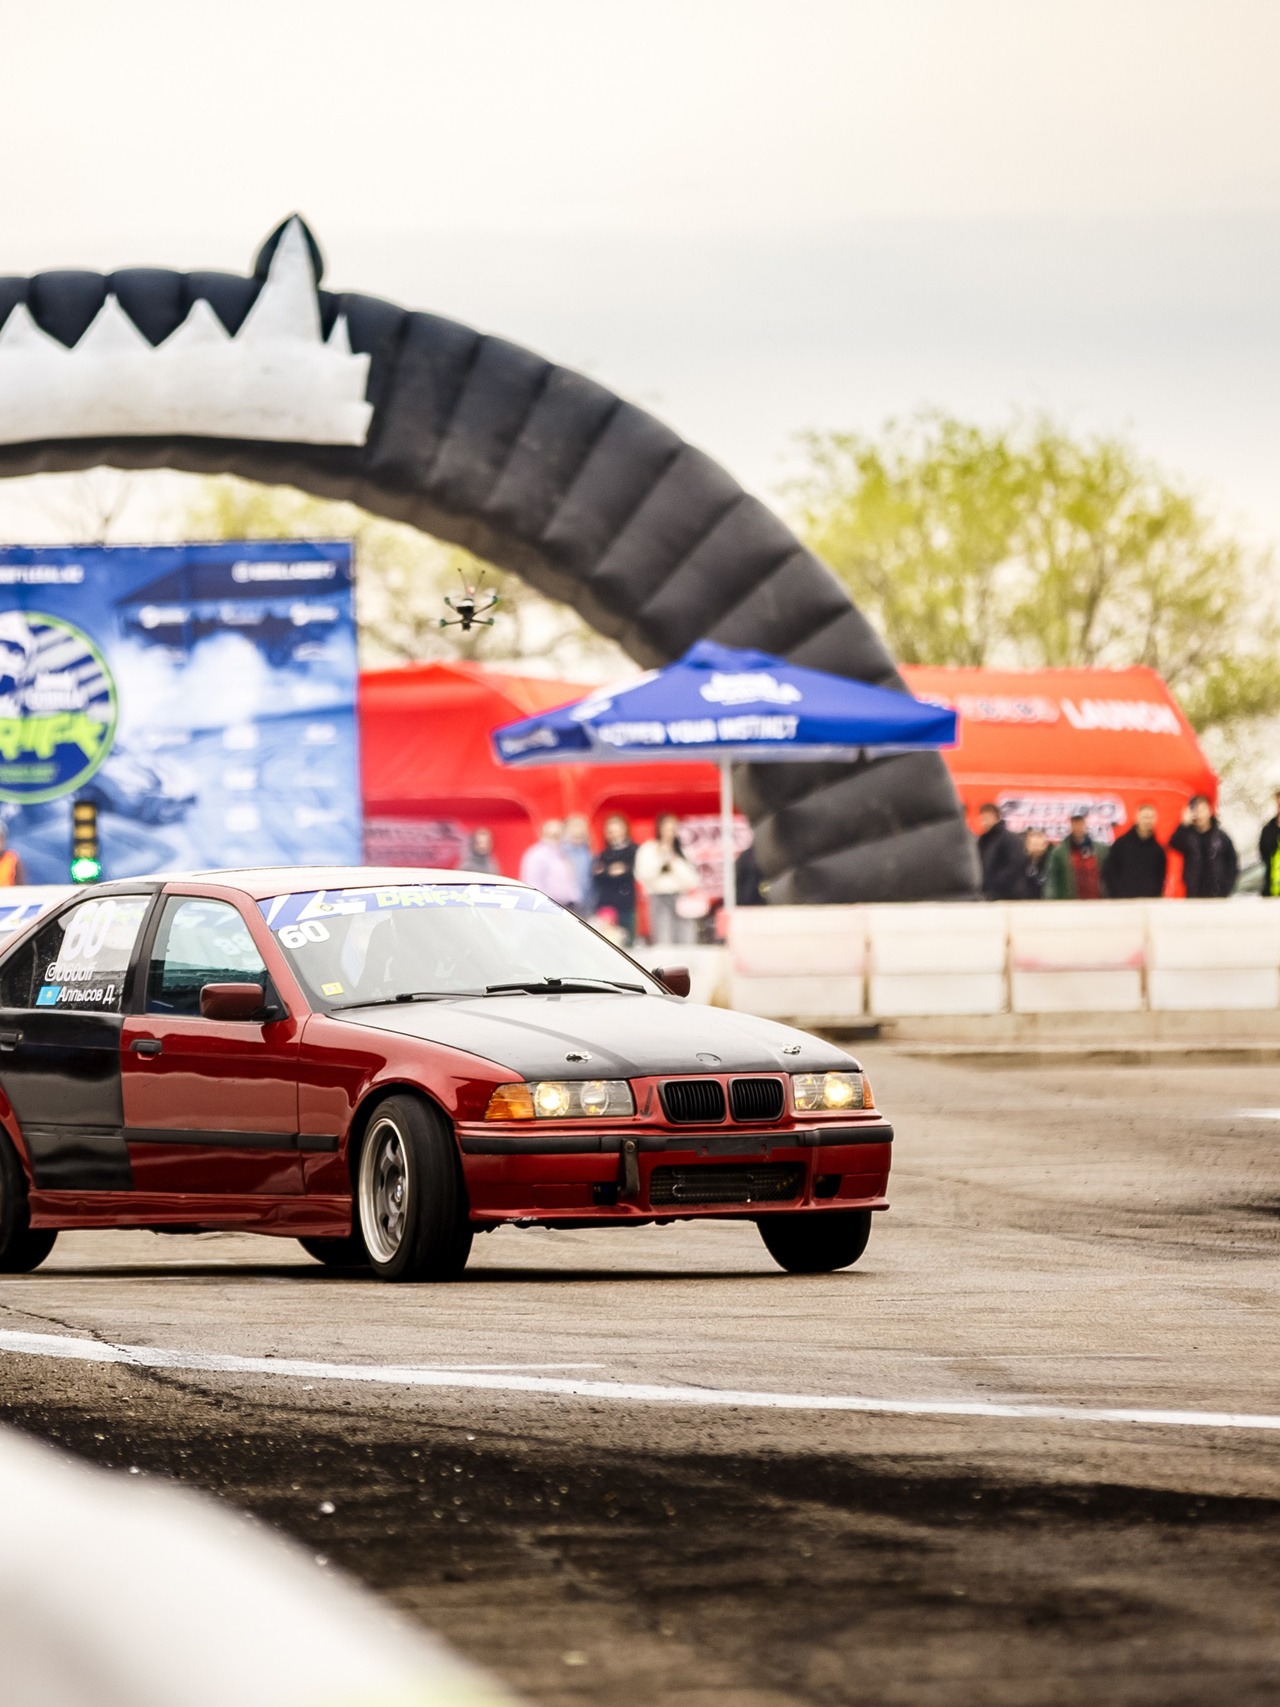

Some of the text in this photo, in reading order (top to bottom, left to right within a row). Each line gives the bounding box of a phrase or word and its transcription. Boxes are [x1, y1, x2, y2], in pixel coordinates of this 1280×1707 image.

[1061, 699, 1181, 735] LAUNCH
[61, 900, 116, 961] 60
[278, 920, 330, 949] 60
